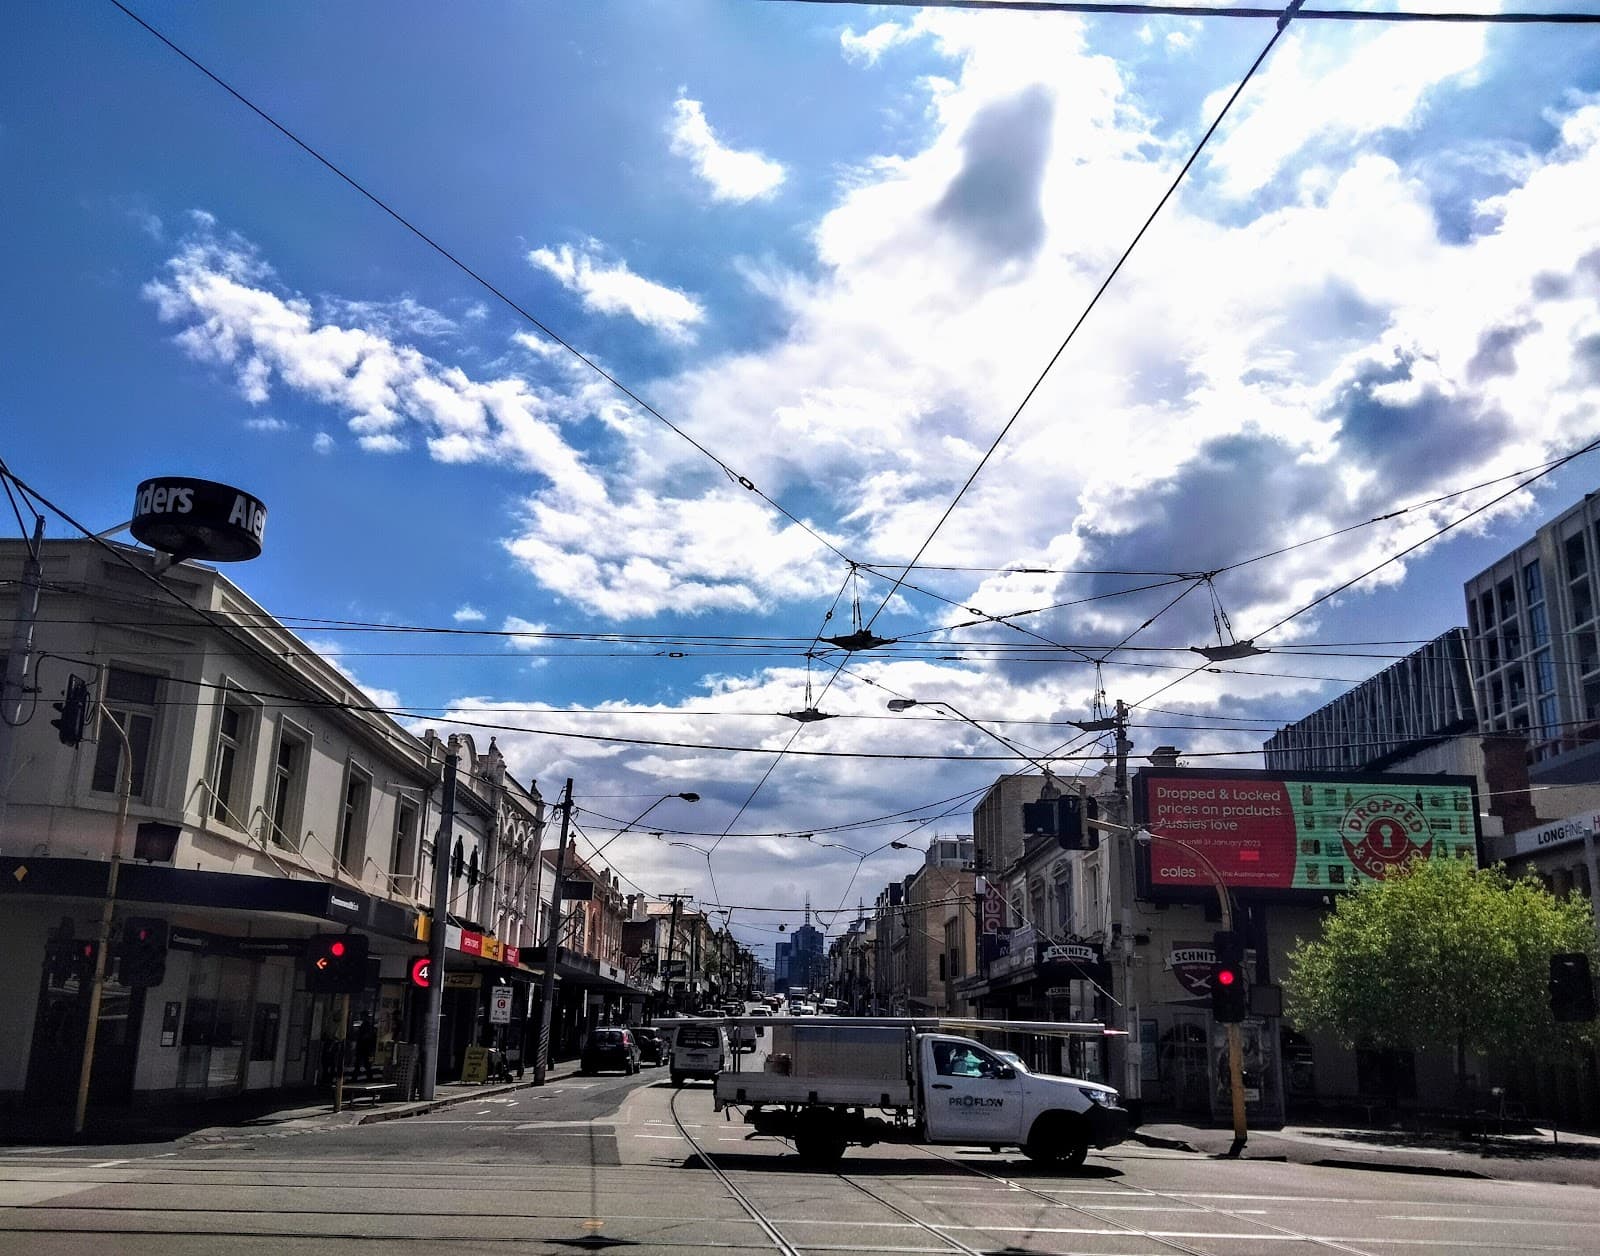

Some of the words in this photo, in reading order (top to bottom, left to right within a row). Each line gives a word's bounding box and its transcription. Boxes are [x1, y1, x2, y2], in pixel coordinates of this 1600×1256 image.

[1157, 787, 1215, 801] Dropped
[1219, 788, 1229, 799] &
[1233, 789, 1281, 801] Locked
[1158, 803, 1198, 815] prices
[1201, 805, 1218, 814] on
[1222, 805, 1281, 816] products
[1348, 799, 1422, 832] DROPPED
[1159, 818, 1207, 829] Aussies
[1210, 819, 1238, 831] love
[1212, 840, 1242, 848] January
[1353, 847, 1366, 860] &
[1364, 848, 1425, 875] LOKED
[1160, 866, 1196, 878] coles
[985, 887, 1001, 932] oles
[1051, 946, 1089, 957] SCHNITZ
[1174, 951, 1217, 962] SCHNIT
[418, 966, 429, 979] 4
[948, 1095, 1004, 1108] PROFLOW
